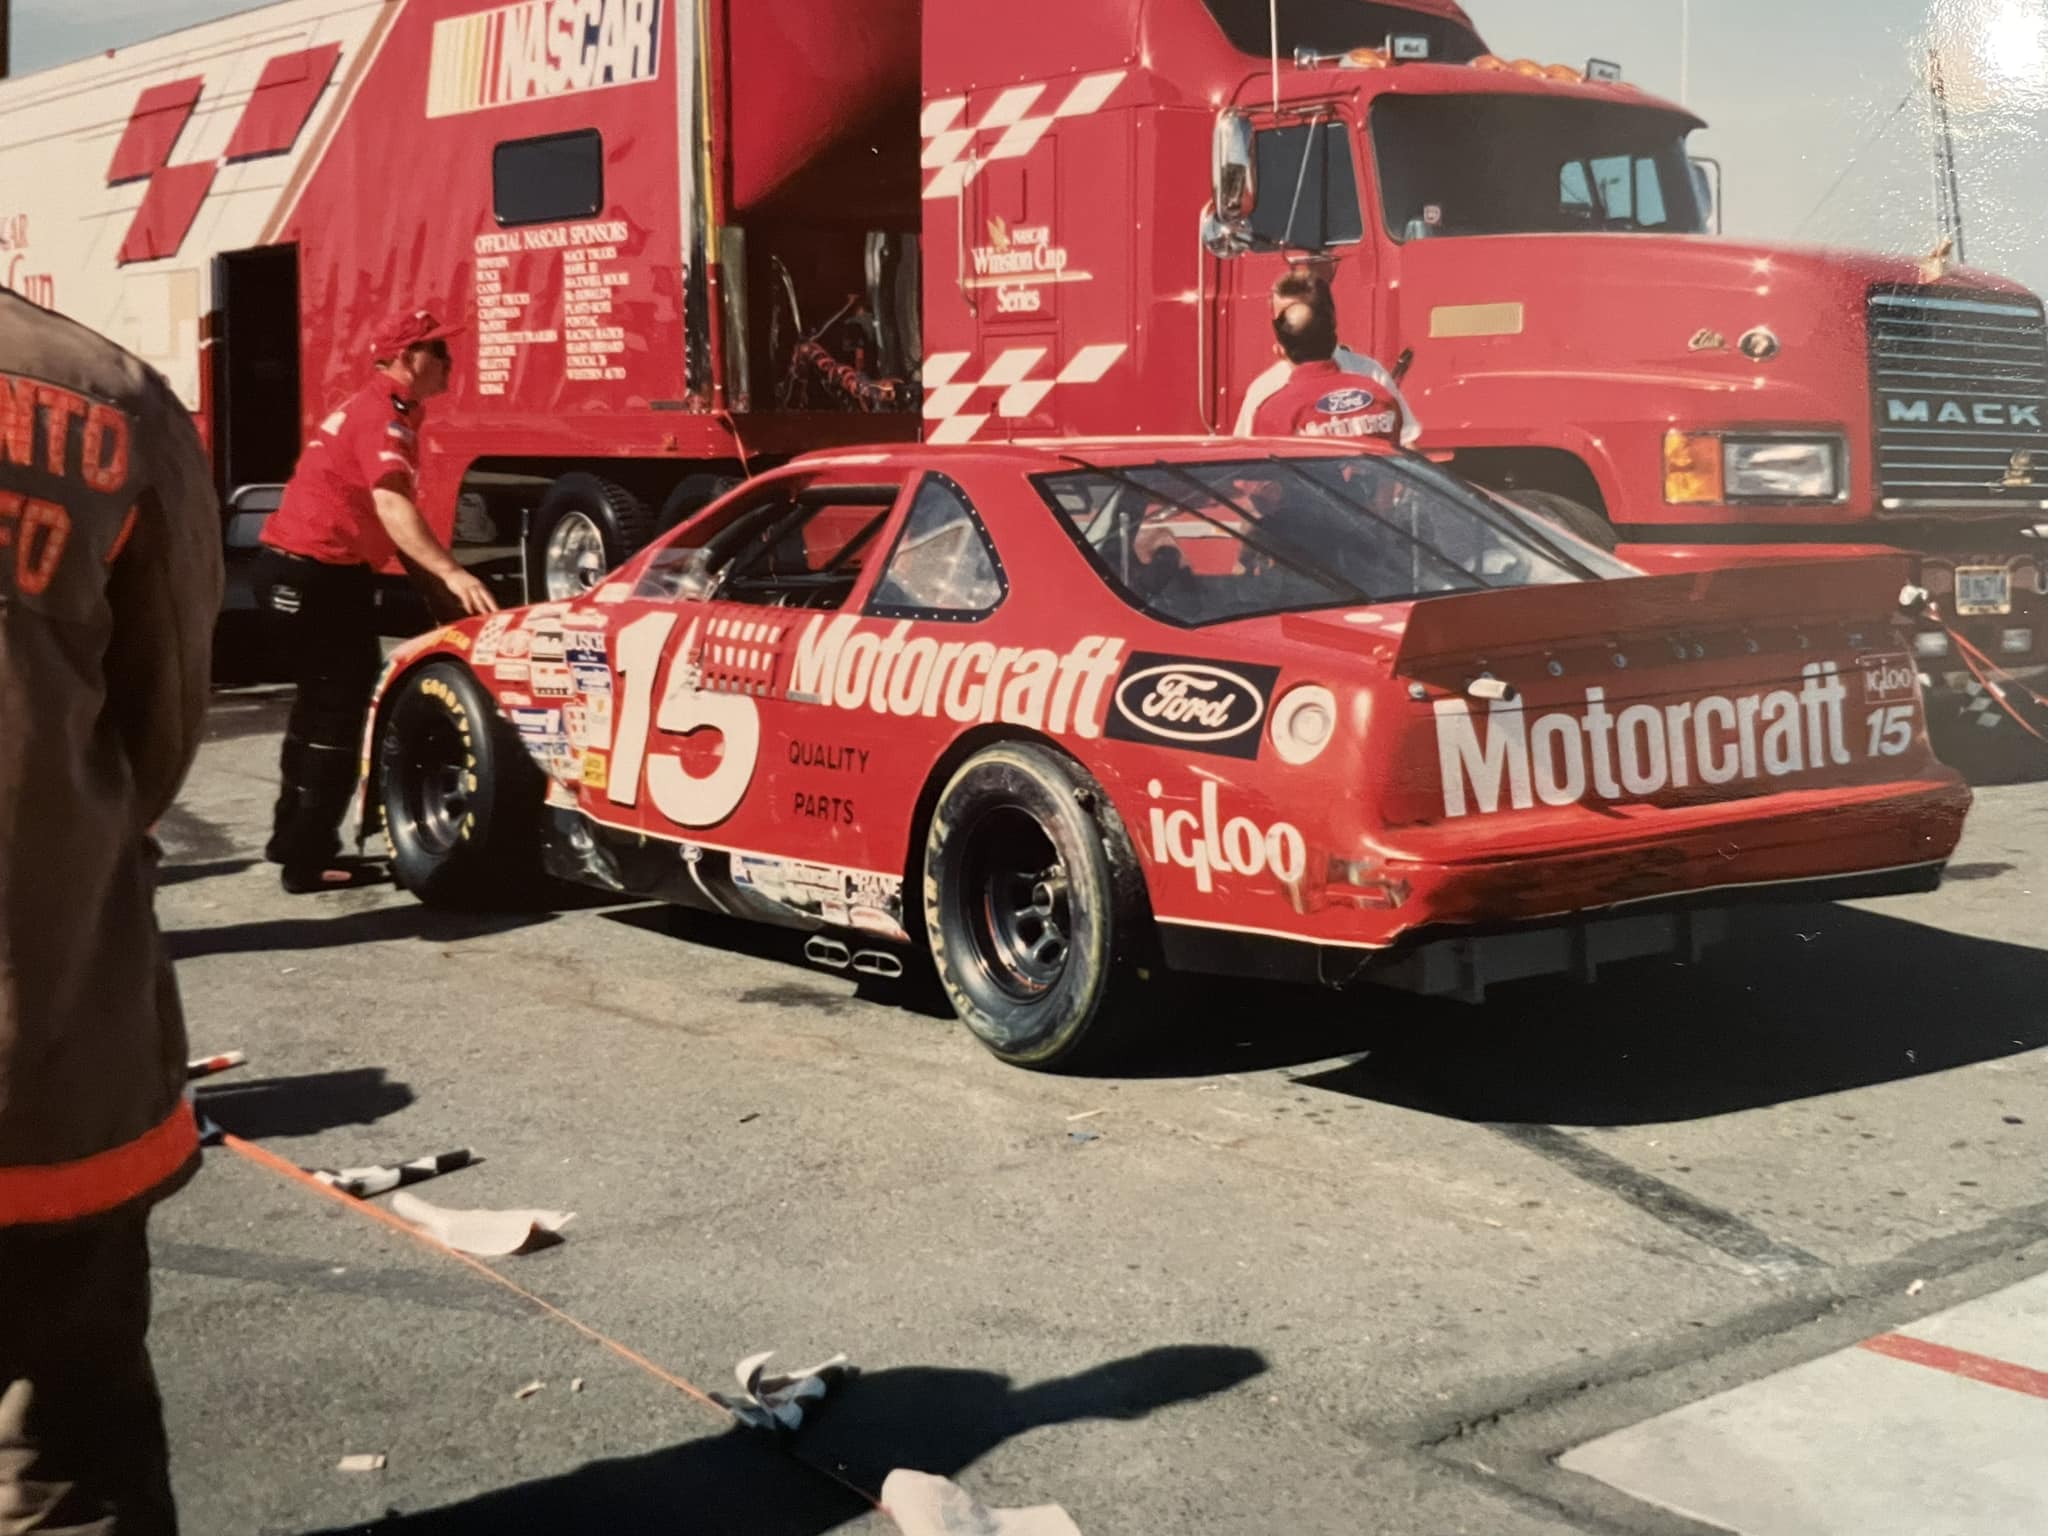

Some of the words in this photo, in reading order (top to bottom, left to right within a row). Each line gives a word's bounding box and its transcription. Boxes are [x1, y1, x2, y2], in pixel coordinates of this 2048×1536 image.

[498, 0, 655, 100] NASCAR
[475, 231, 521, 254] OFFICIAL
[523, 226, 568, 249] NASCAR
[570, 221, 628, 245] SPONSORS
[1012, 226, 1049, 245] NASCAR
[971, 247, 1033, 275] Winston
[1034, 243, 1067, 279] Cup
[997, 280, 1040, 313] Series
[1328, 391, 1364, 411] Ford
[1887, 399, 2042, 426] MACK
[788, 613, 1126, 738] Motorcraft
[1142, 673, 1236, 727] Ford
[607, 611, 761, 830] 15
[1866, 705, 1915, 757] 15
[787, 739, 870, 773] QUALITY
[1433, 660, 1851, 818] Motorcraft
[794, 792, 855, 825] PARTS
[1147, 778, 1306, 894] igloo
